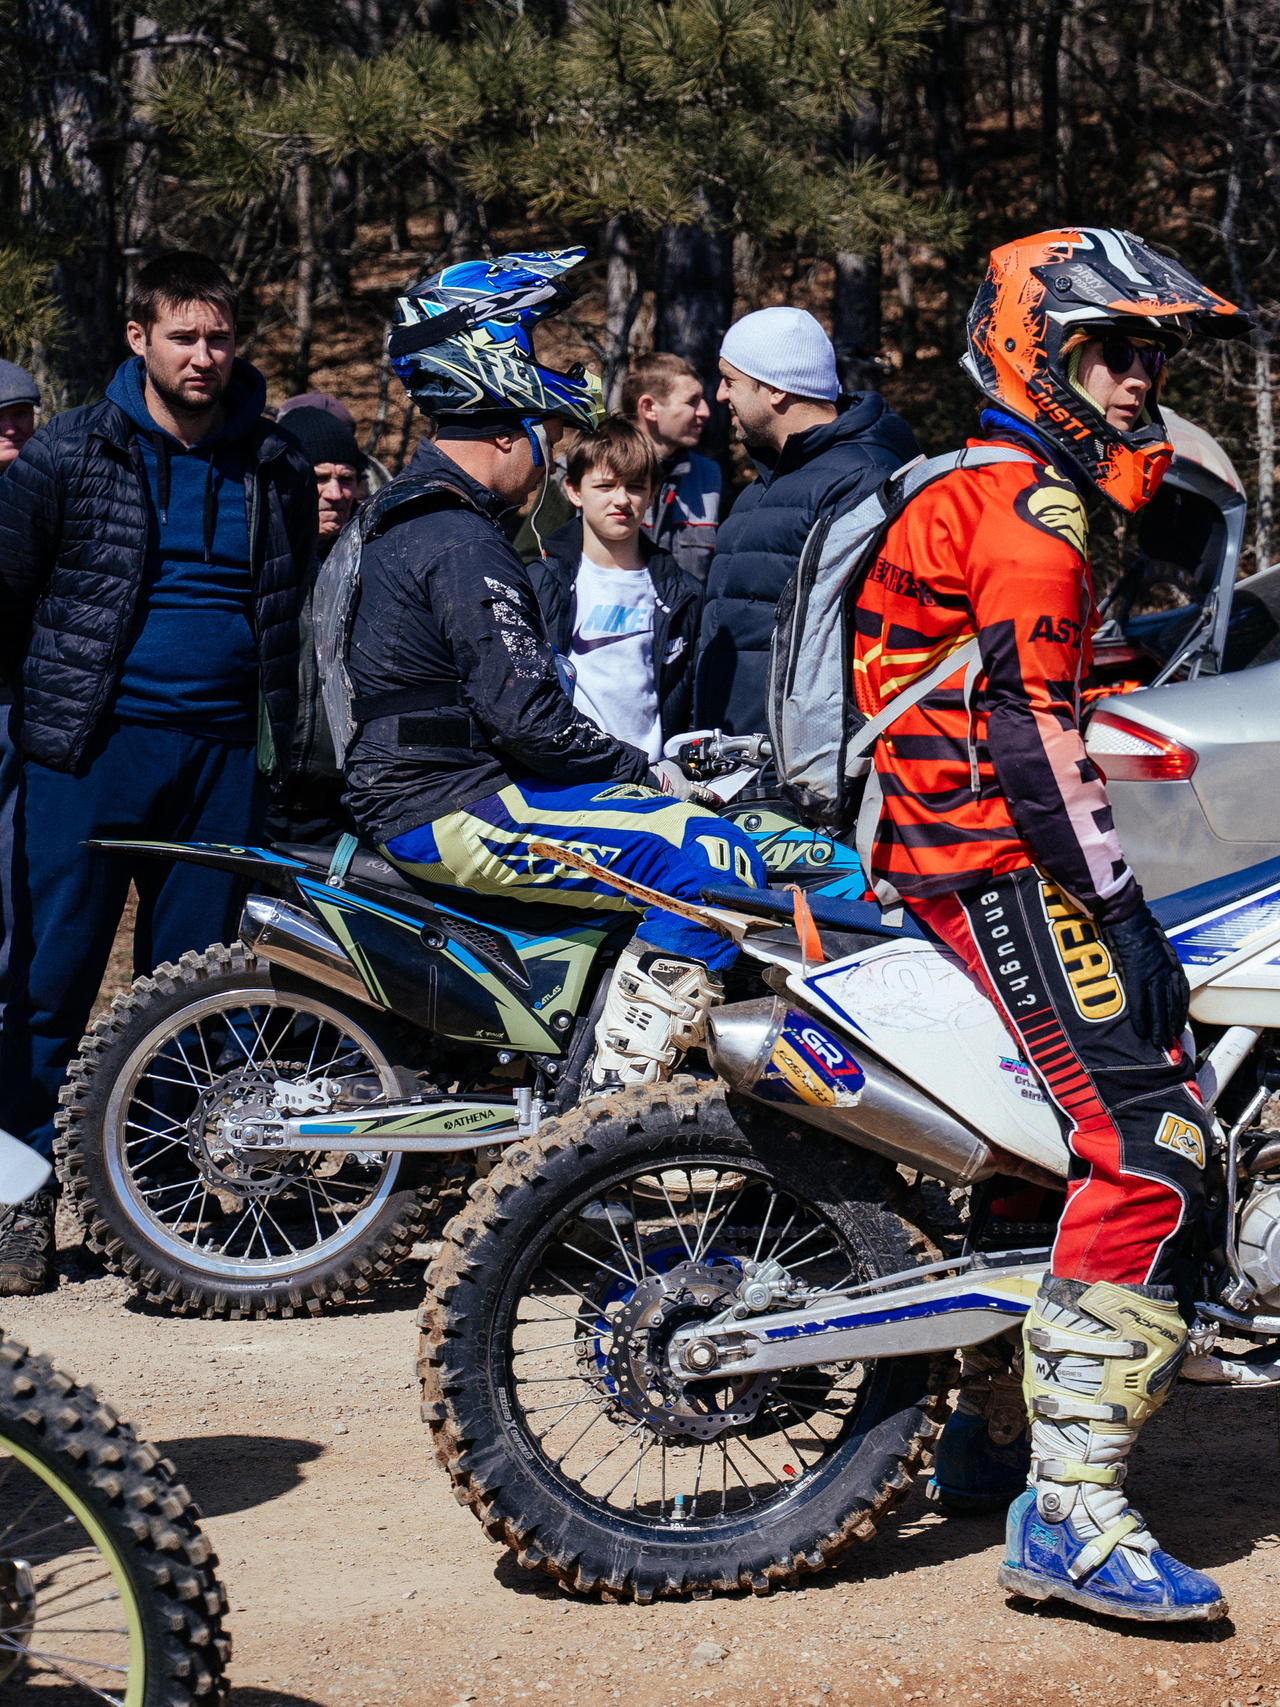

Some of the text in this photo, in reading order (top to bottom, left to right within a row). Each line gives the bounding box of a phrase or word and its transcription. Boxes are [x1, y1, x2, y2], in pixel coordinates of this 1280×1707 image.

[1027, 389, 1092, 440] JUST1
[583, 604, 647, 633] NIKE
[981, 891, 1037, 1007] enough?
[541, 985, 561, 1005] ATLAS
[801, 1028, 859, 1071] GR7
[454, 1110, 495, 1128] ATHENA
